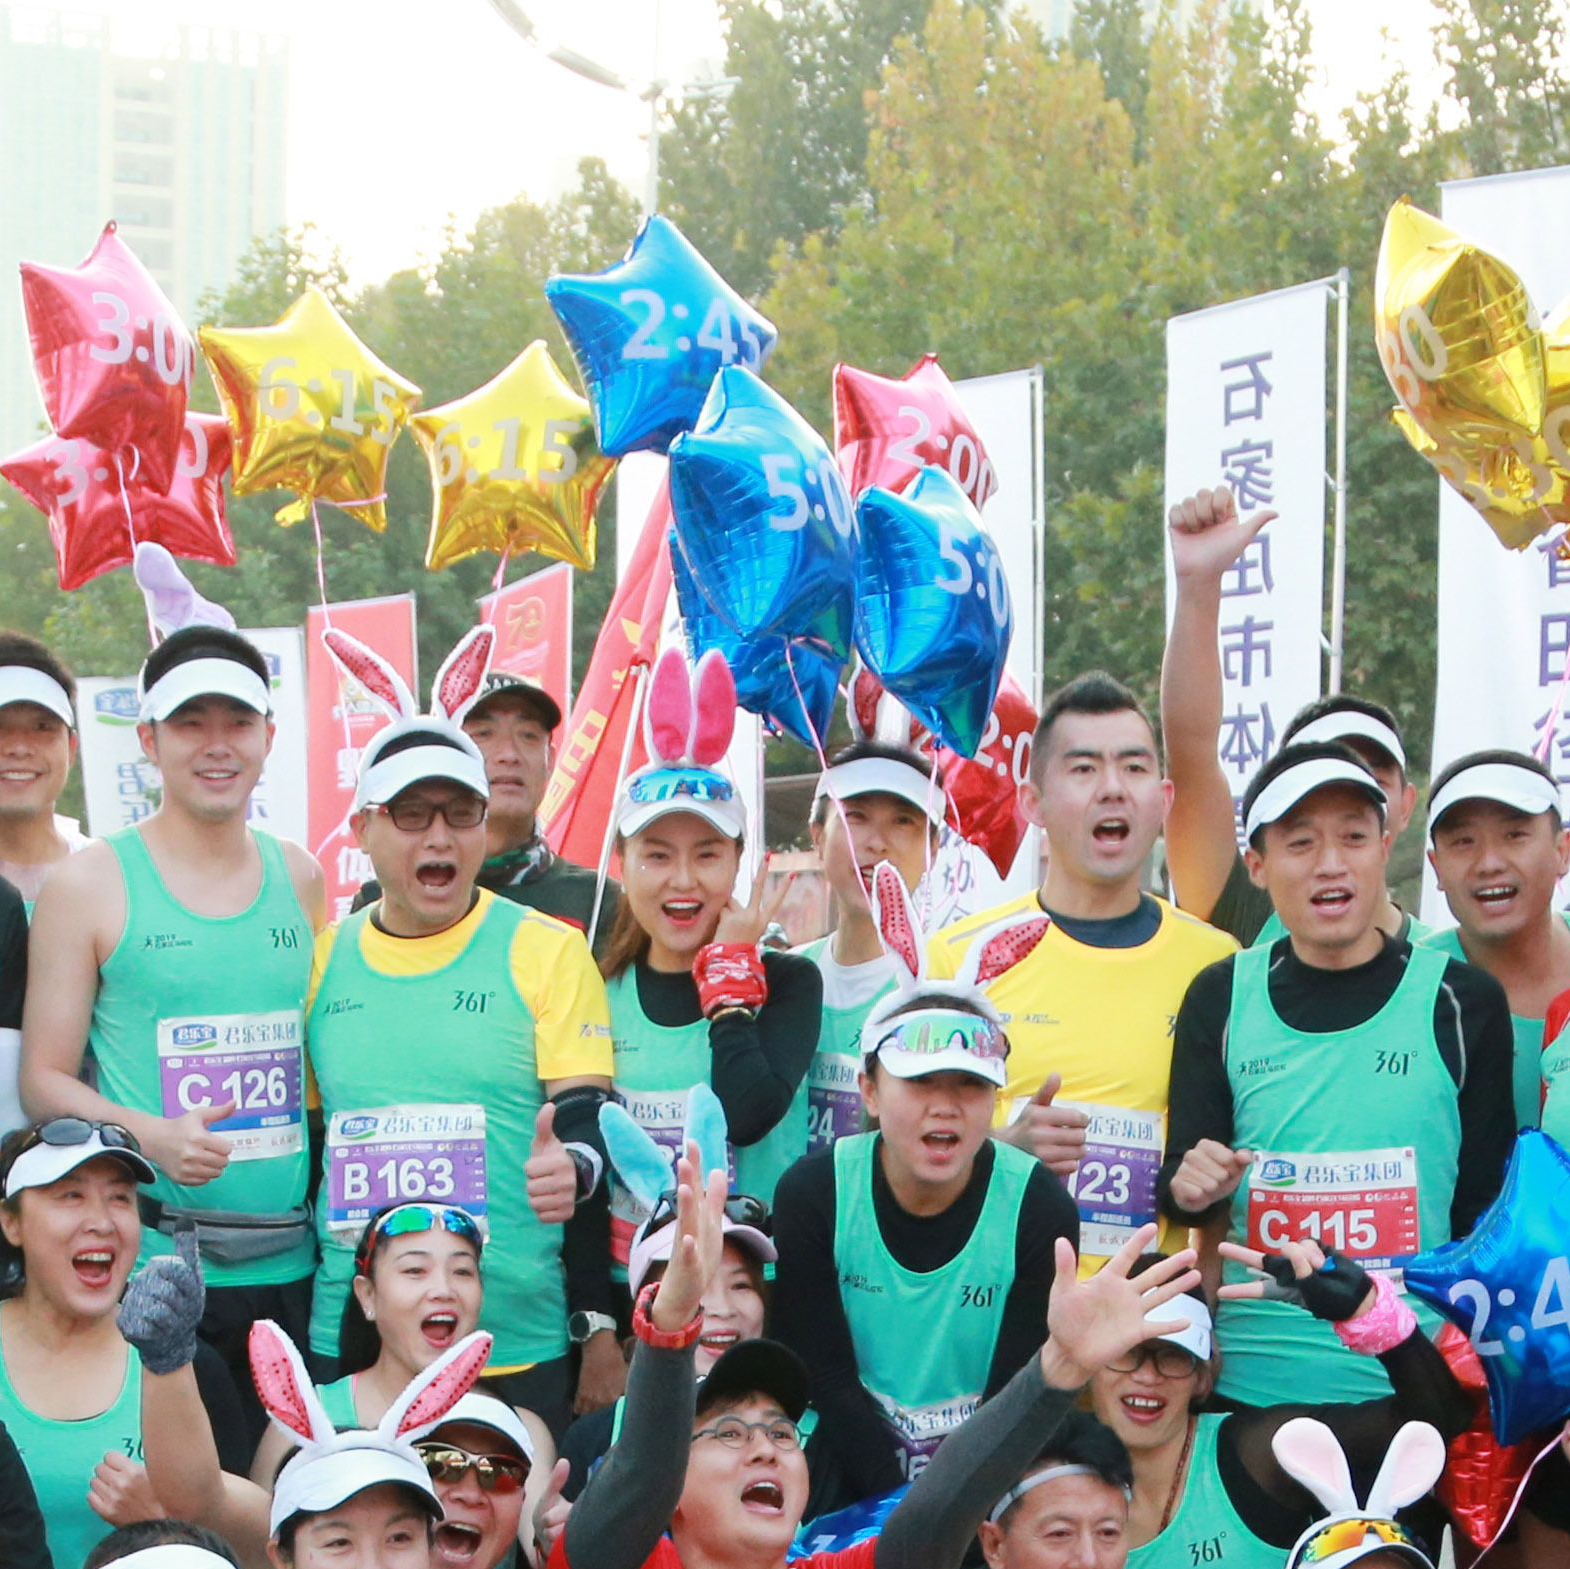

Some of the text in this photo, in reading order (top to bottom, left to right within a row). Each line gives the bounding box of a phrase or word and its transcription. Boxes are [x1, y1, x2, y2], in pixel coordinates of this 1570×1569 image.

[620, 289, 767, 373] 2:45
[256, 356, 399, 445] 6:15
[50, 427, 207, 506] 3:0
[434, 417, 581, 488] 6:15
[453, 990, 496, 1014] 361°
[224, 1022, 297, 1044] 君乐宝集团
[1248, 1058, 1270, 1068] 2019
[1375, 1050, 1418, 1076] 361°
[178, 1066, 288, 1113] C 126
[382, 1115, 473, 1135] 君乐宝集团
[344, 1158, 455, 1201] B 163
[1303, 1161, 1403, 1184] 君乐宝集团
[1259, 1209, 1379, 1251] C 115
[960, 1283, 1002, 1308] 361°
[1188, 1531, 1226, 1567] 361°
